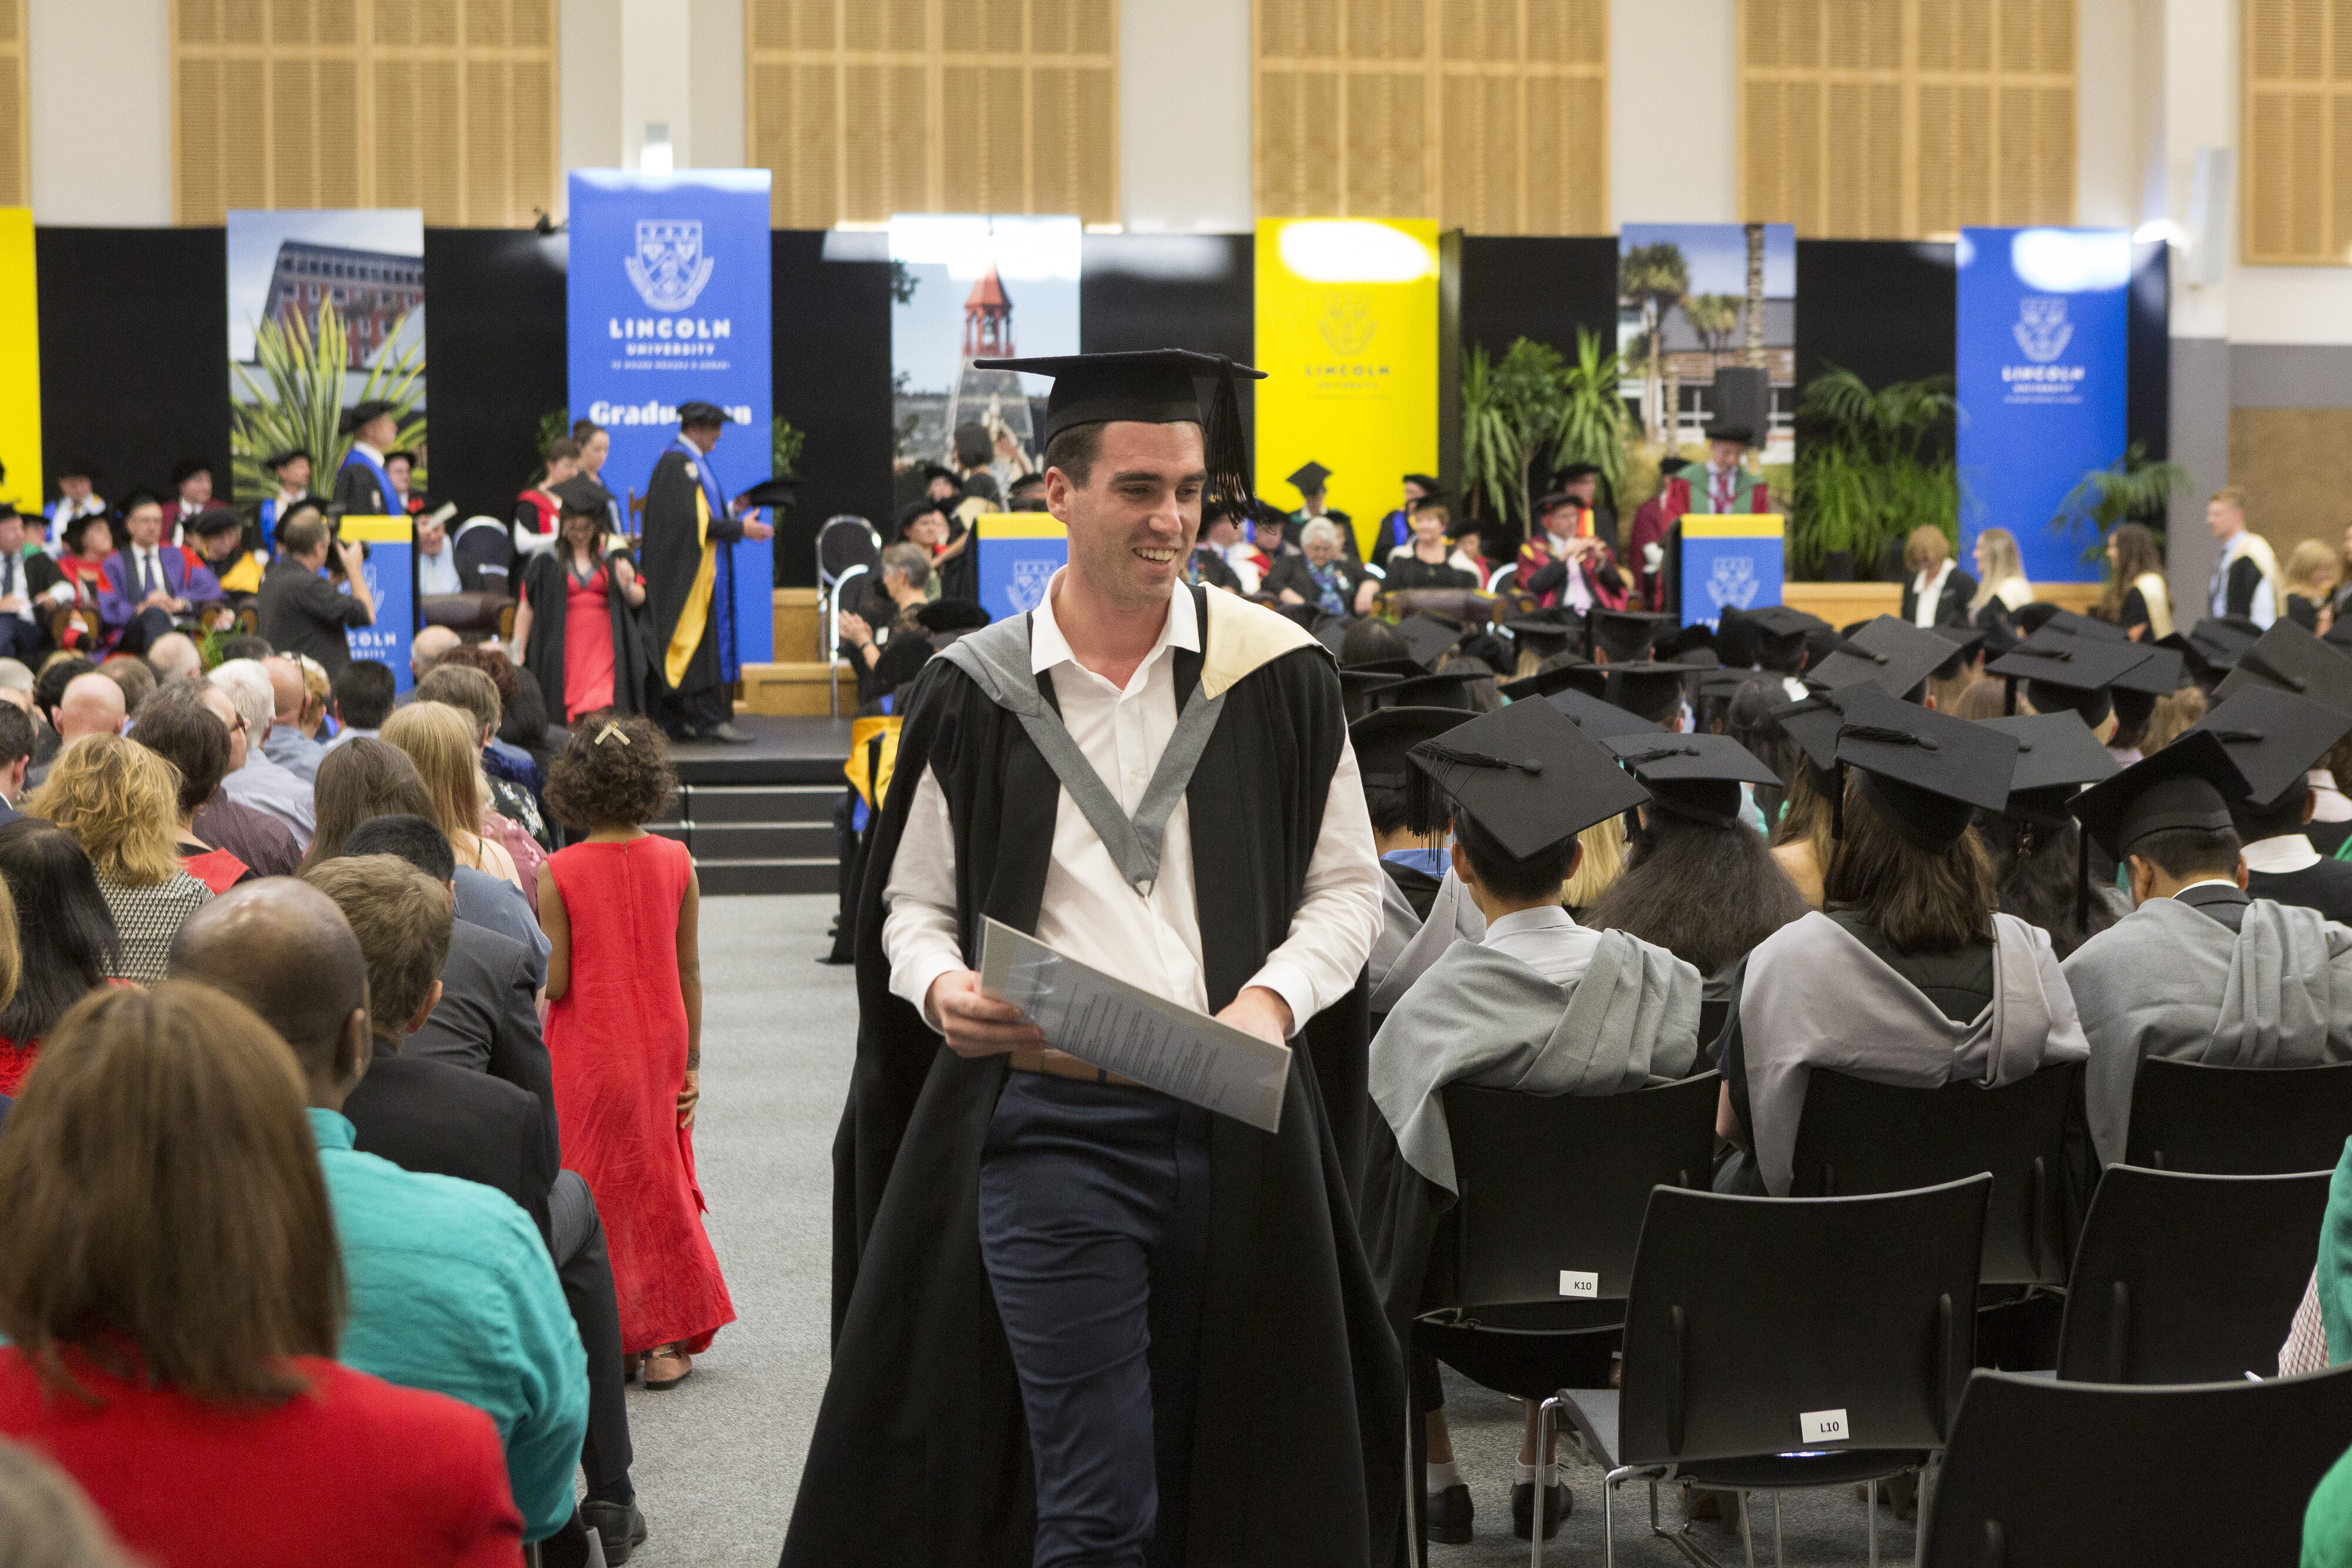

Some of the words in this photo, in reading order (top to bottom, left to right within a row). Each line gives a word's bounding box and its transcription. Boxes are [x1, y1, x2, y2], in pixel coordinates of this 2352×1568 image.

[609, 318, 731, 339] LINCOLN
[1305, 365, 1390, 376] LINCOLN
[589, 400, 752, 425] Gradun
[348, 630, 396, 647] COLN
[1574, 1281, 1592, 1290] K10
[1820, 1422, 1839, 1433] L10
